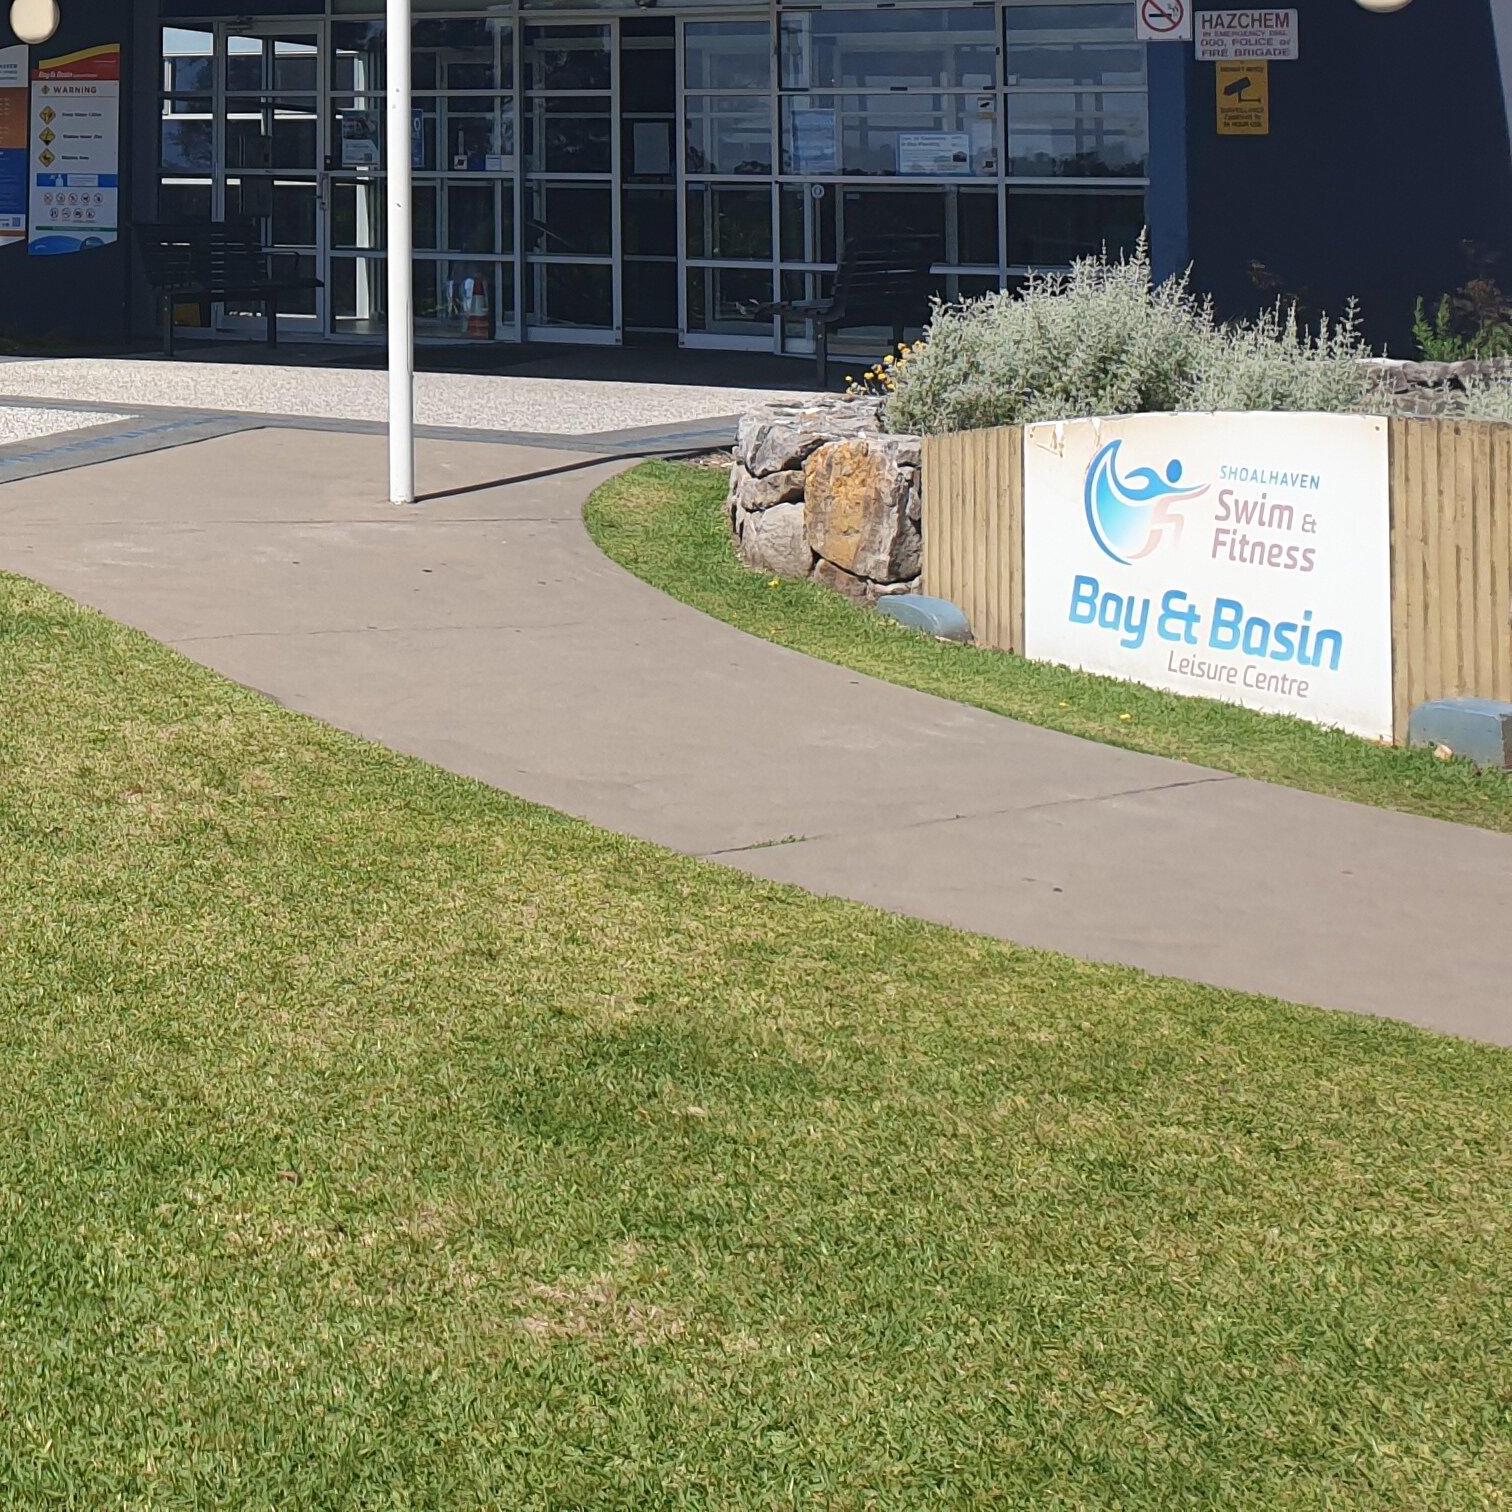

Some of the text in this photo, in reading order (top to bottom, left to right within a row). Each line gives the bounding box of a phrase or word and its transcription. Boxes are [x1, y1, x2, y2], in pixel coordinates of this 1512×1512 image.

[1201, 12, 1290, 29] HAZCHEM
[1201, 48, 1289, 57] FIRE BRIGADE
[1231, 37, 1274, 46] POLICE
[53, 86, 97, 94] WARNING
[1219, 465, 1321, 490] SHOALHAVEN
[1214, 489, 1317, 534] Swim &
[1211, 527, 1316, 572] Fitness
[1068, 574, 1343, 672] Bay & Basin
[1168, 649, 1310, 698] Leisure Centre
